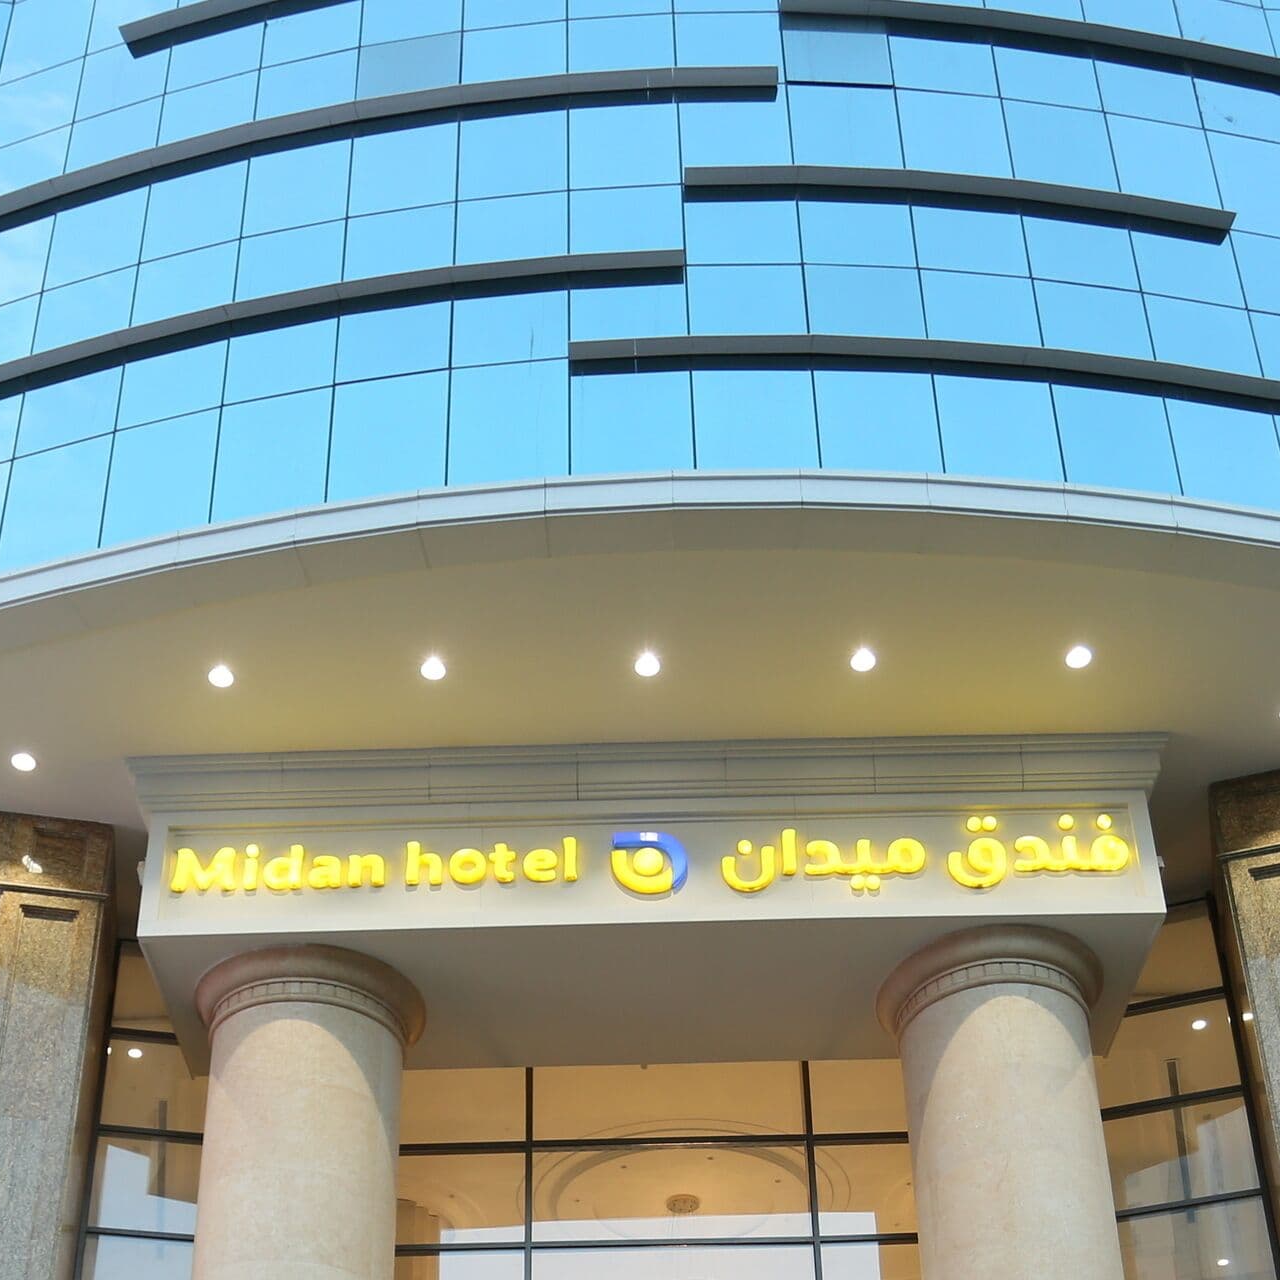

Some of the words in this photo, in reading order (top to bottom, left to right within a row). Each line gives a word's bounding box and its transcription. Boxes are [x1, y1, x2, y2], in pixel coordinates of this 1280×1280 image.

[170, 843, 385, 893] Midan
[405, 836, 579, 886] hotel
[721, 827, 927, 892] ميدان
[947, 813, 1131, 889] فندق
